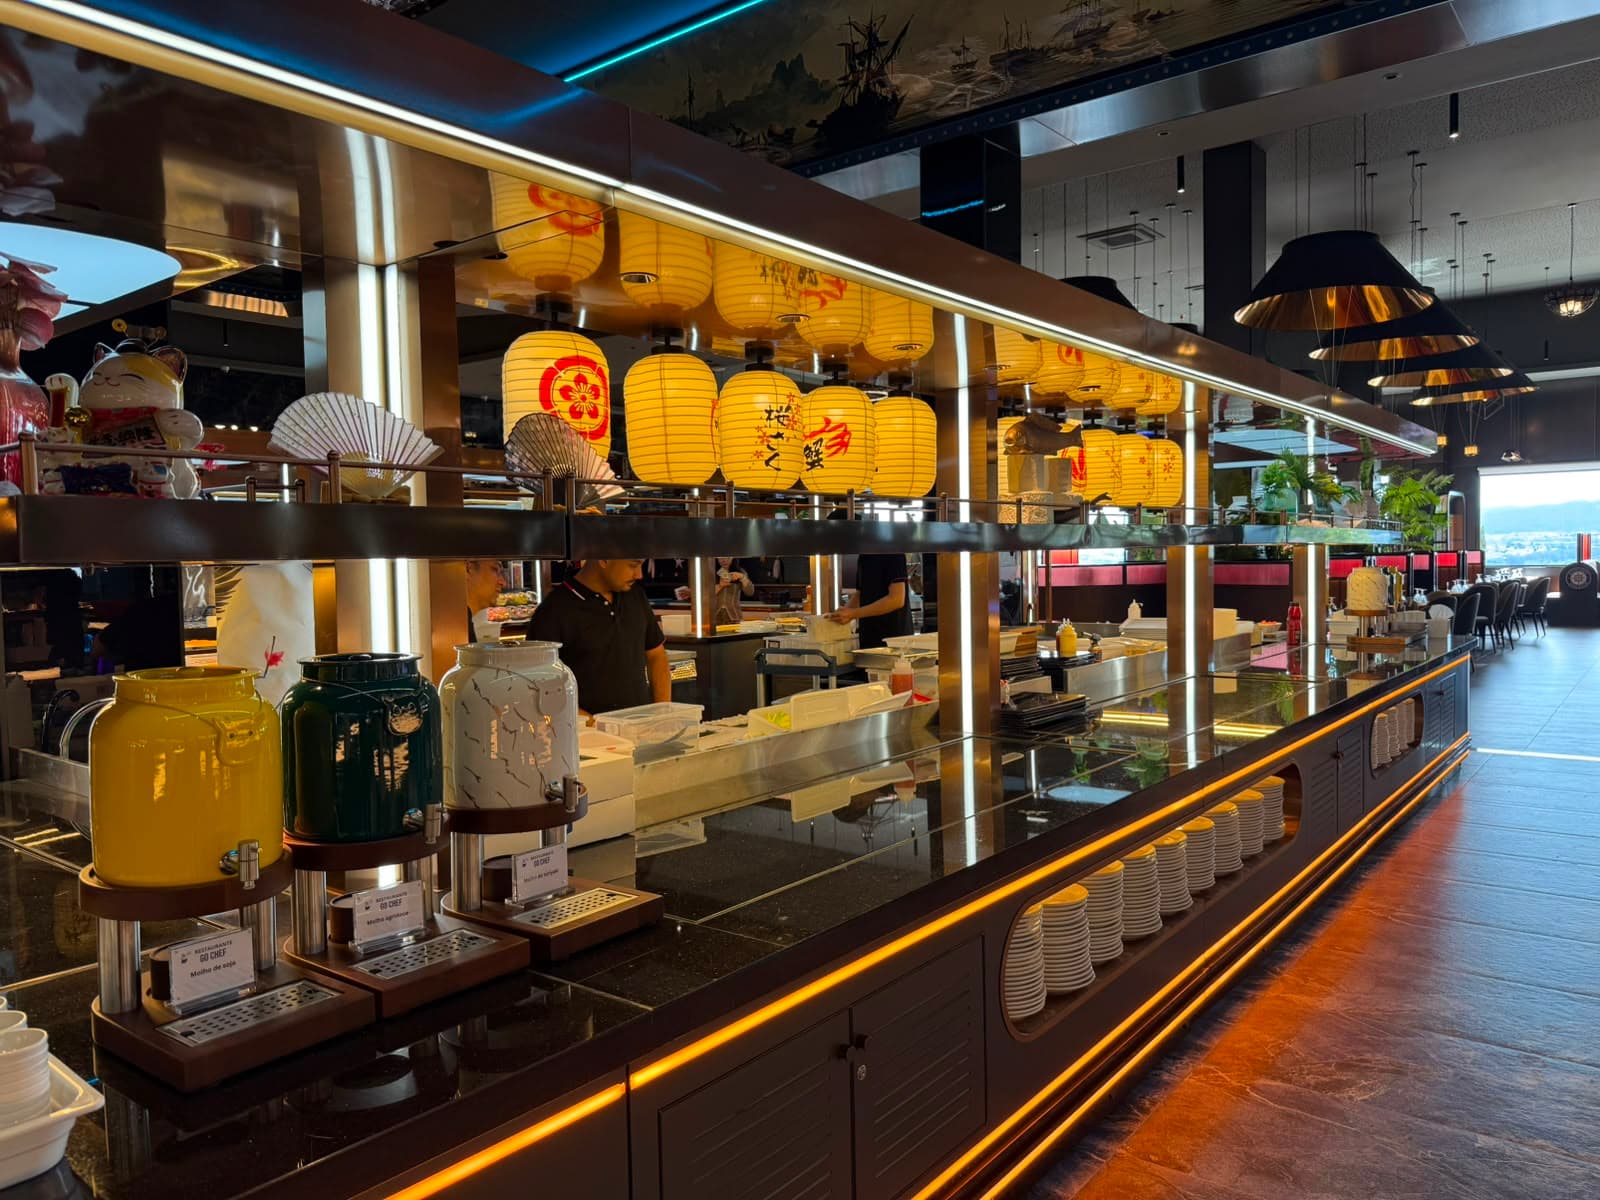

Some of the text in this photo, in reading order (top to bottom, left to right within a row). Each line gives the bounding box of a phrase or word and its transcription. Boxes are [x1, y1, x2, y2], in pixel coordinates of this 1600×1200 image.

[379, 898, 402, 911] GO CHEF
[194, 940, 233, 955] RESTAURANTE
[199, 947, 227, 963] GO CHEF
[190, 959, 237, 978] Molho de soja
